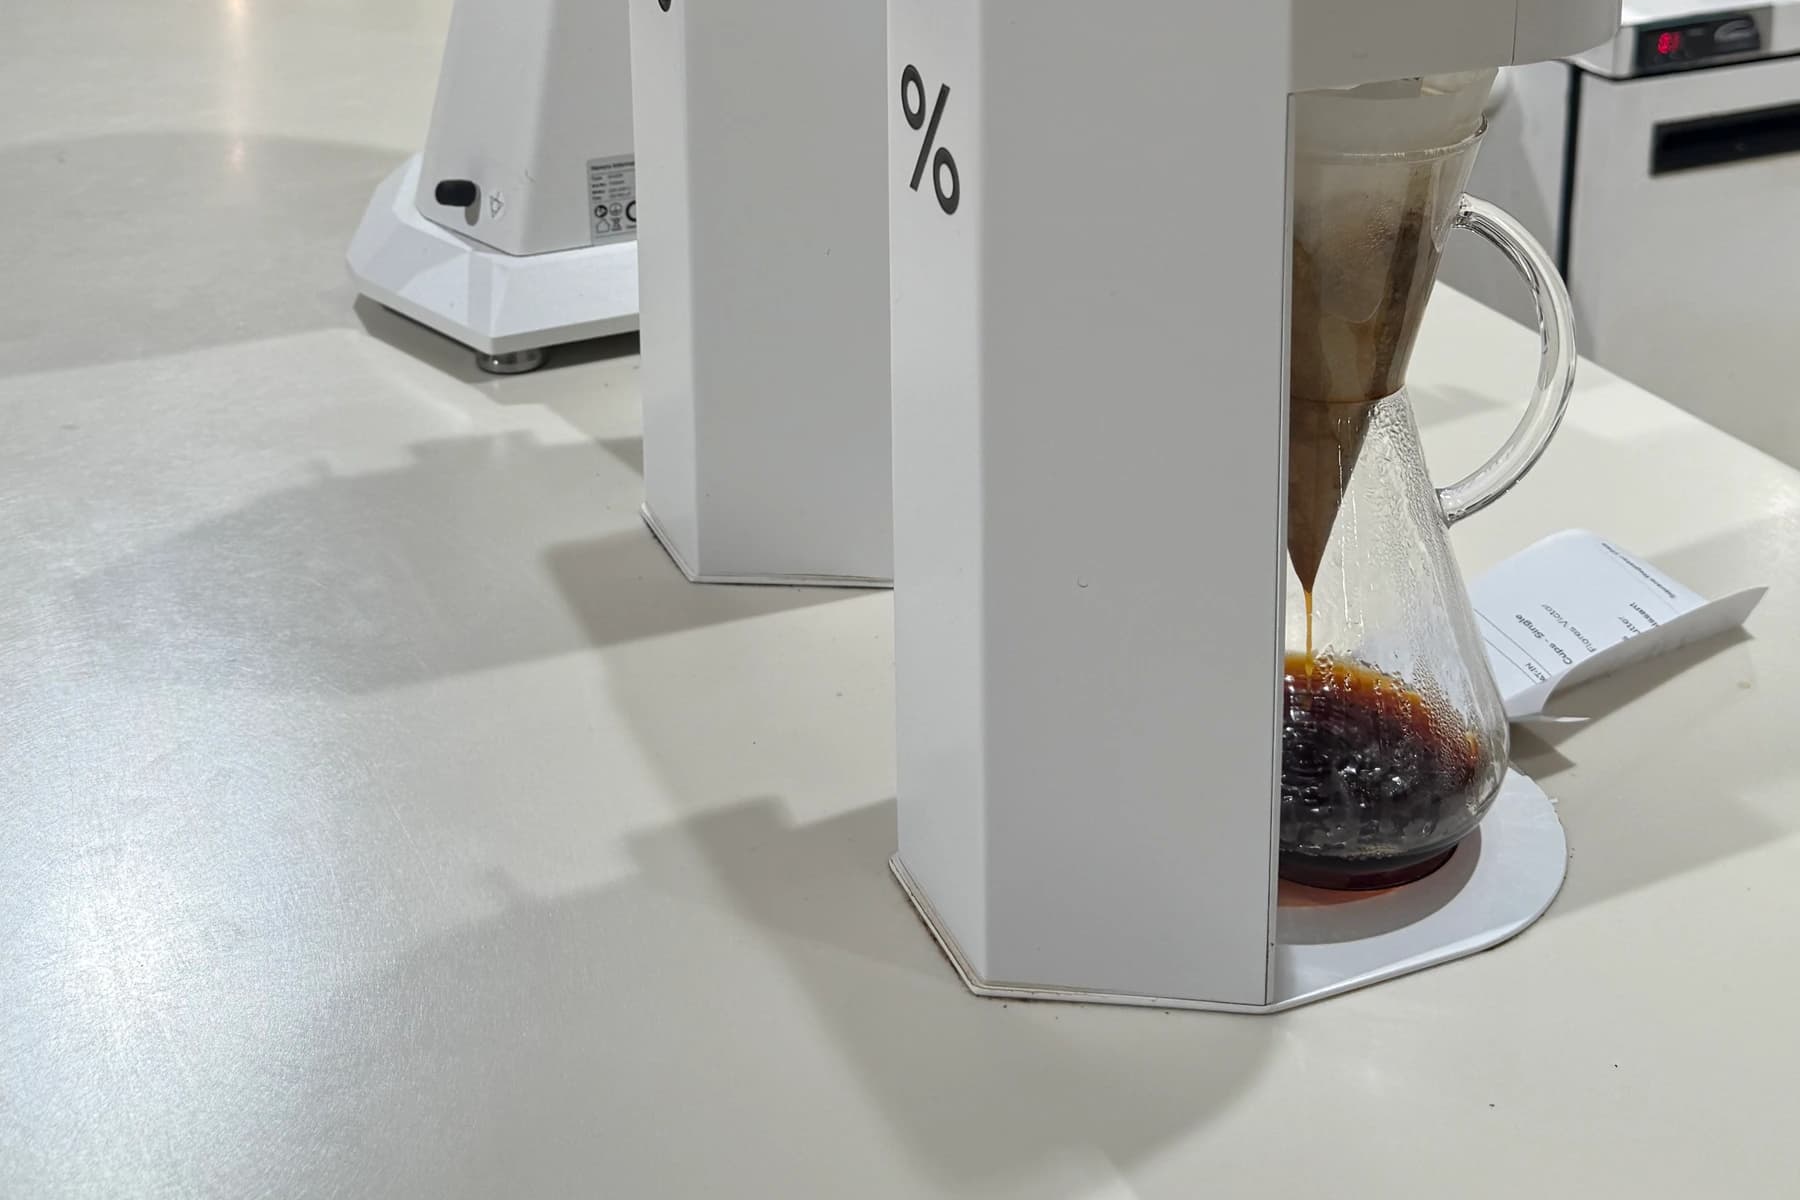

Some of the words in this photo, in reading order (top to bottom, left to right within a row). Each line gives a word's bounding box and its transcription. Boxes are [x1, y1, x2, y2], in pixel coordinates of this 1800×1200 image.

[900, 63, 960, 216] %
[1515, 614, 1545, 639] Single
[1618, 616, 1641, 634] utter
[1629, 602, 1659, 627] issant
[1549, 642, 1573, 665] Cups
[1525, 662, 1547, 682] AT-IN
